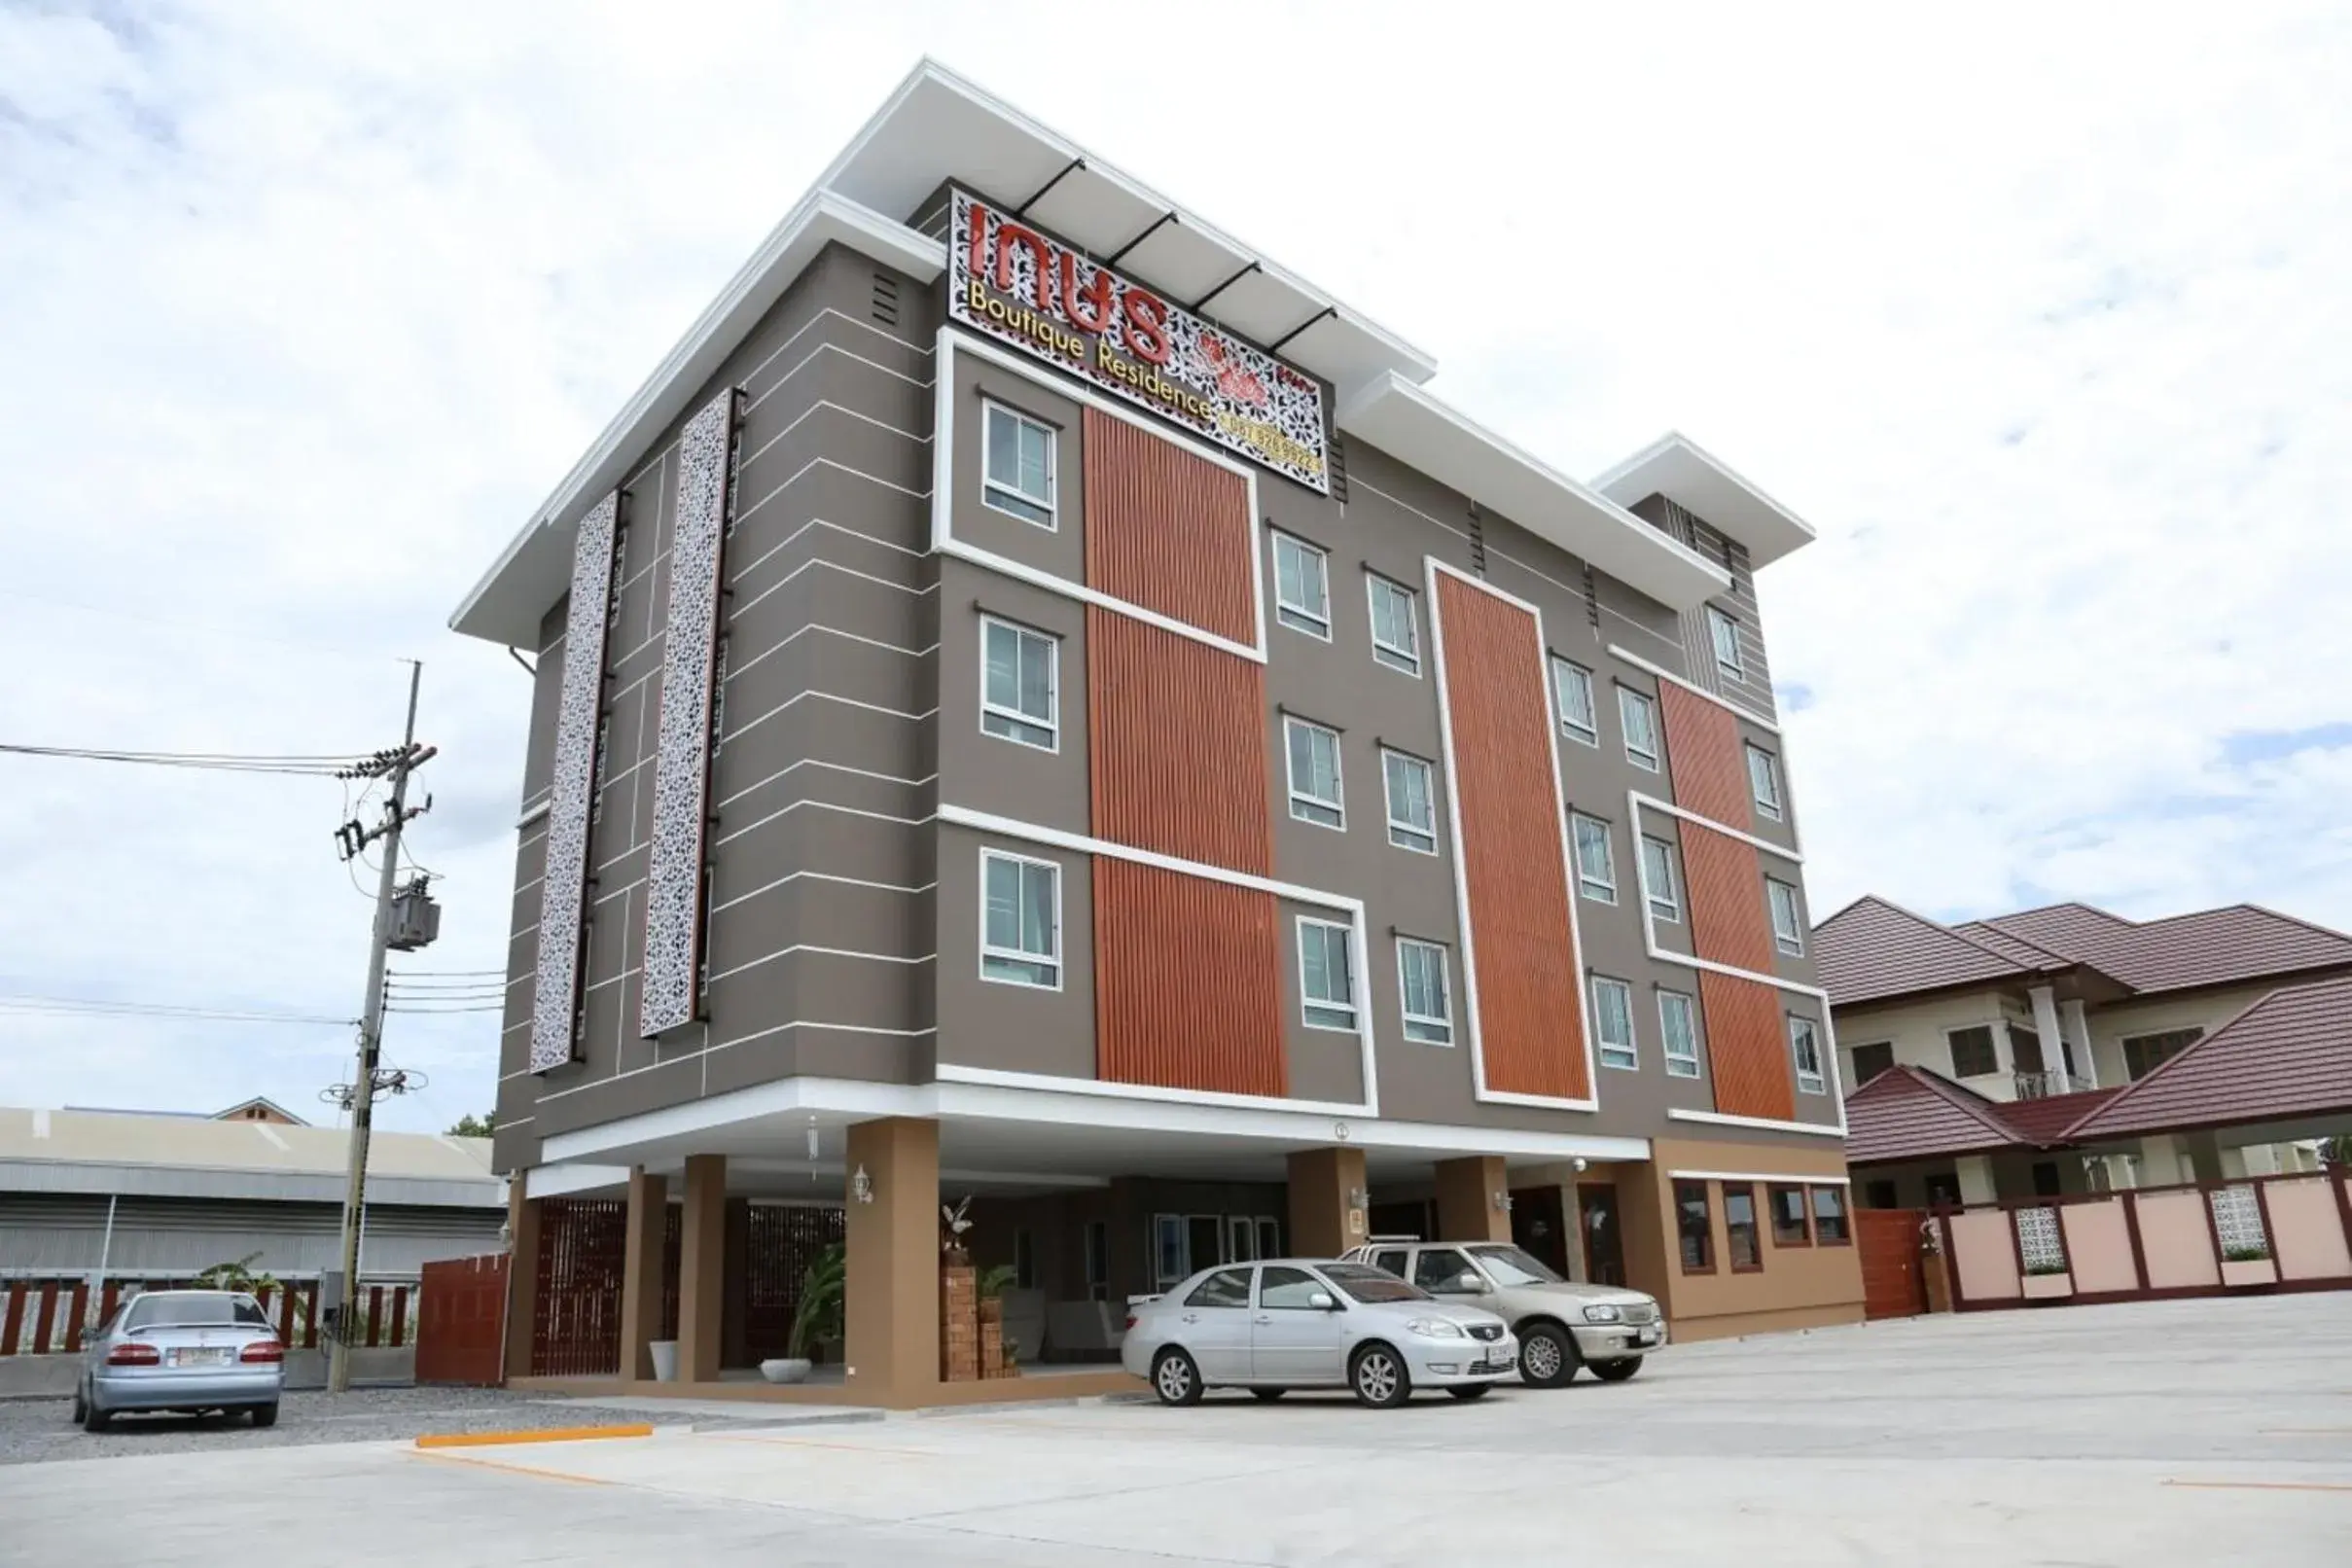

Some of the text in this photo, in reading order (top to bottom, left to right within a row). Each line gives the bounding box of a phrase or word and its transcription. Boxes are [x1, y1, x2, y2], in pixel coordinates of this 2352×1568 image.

[969, 202, 1169, 365] เกษร
[970, 279, 1211, 419] Boutique Residence
